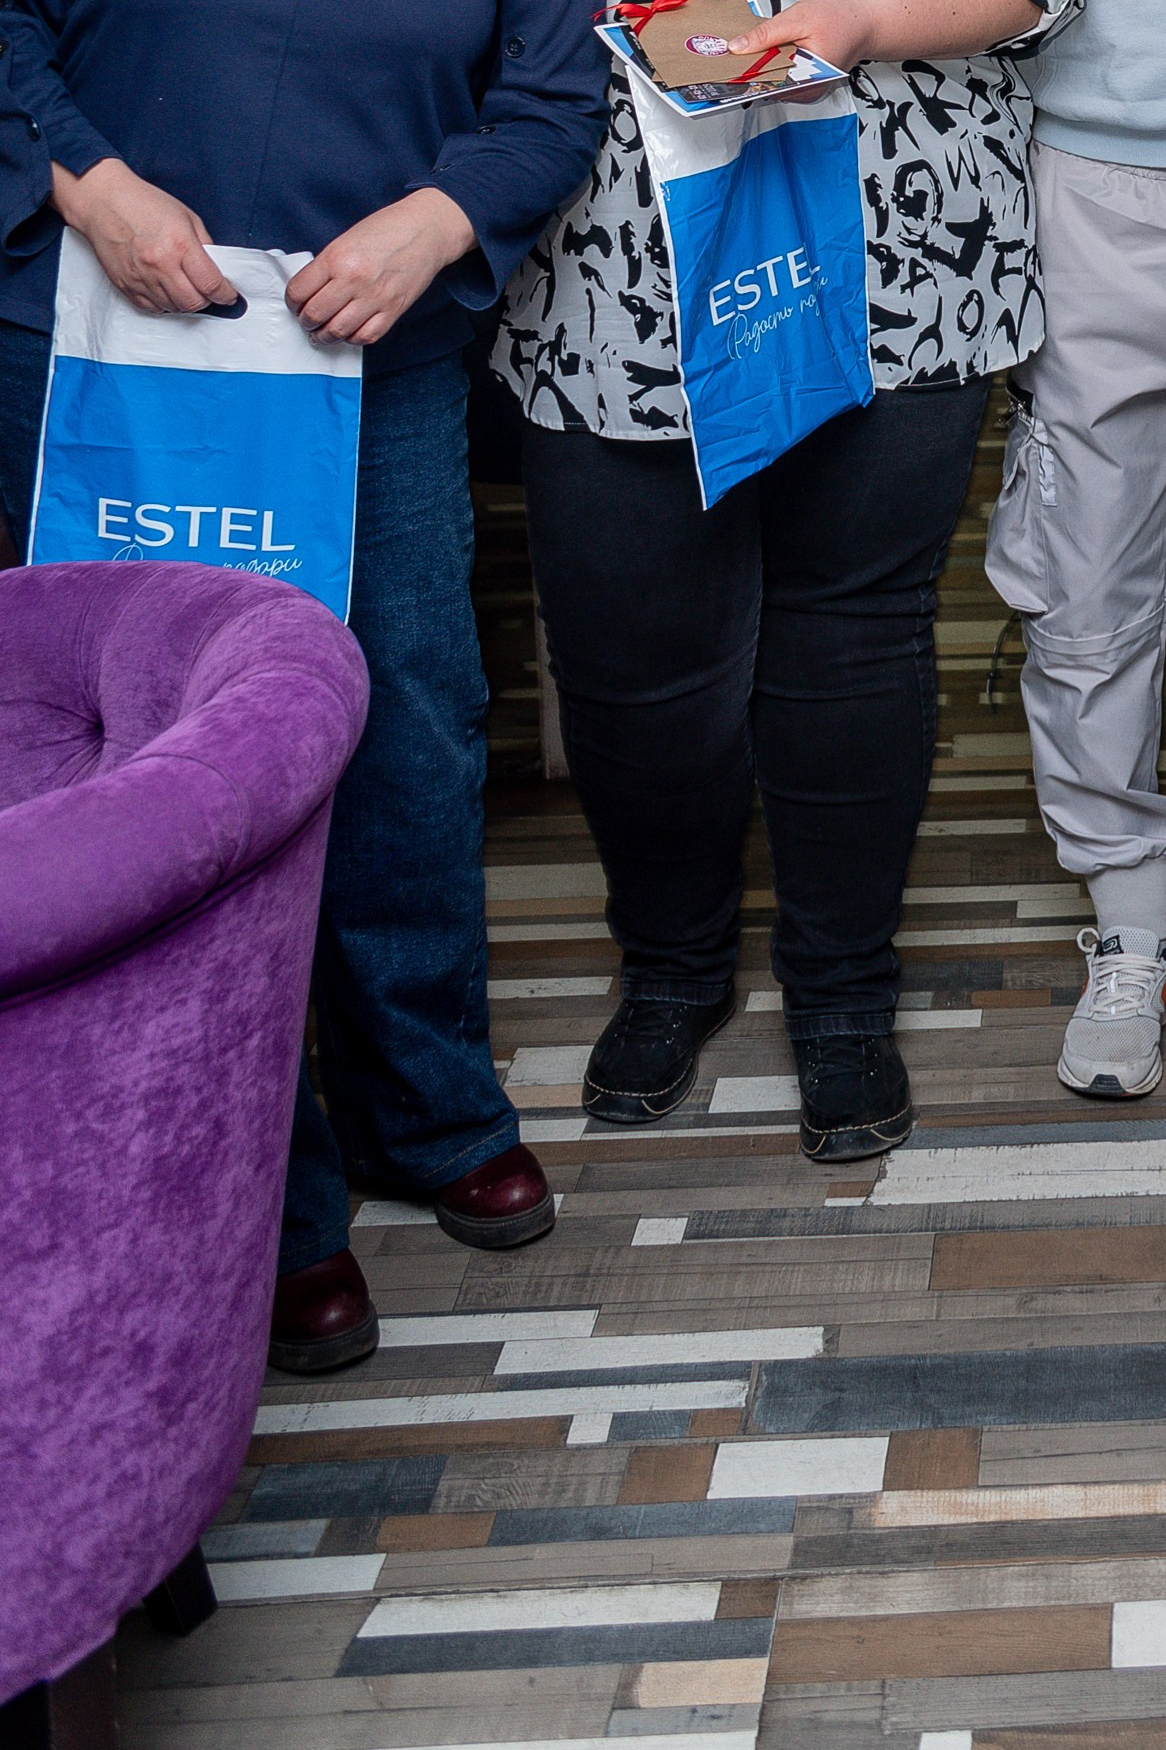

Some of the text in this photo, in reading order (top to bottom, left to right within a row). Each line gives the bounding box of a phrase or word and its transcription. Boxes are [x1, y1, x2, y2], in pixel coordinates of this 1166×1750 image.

[709, 246, 820, 327] ESTE
[727, 306, 794, 360] Радость
[98, 497, 296, 552] ESTEL
